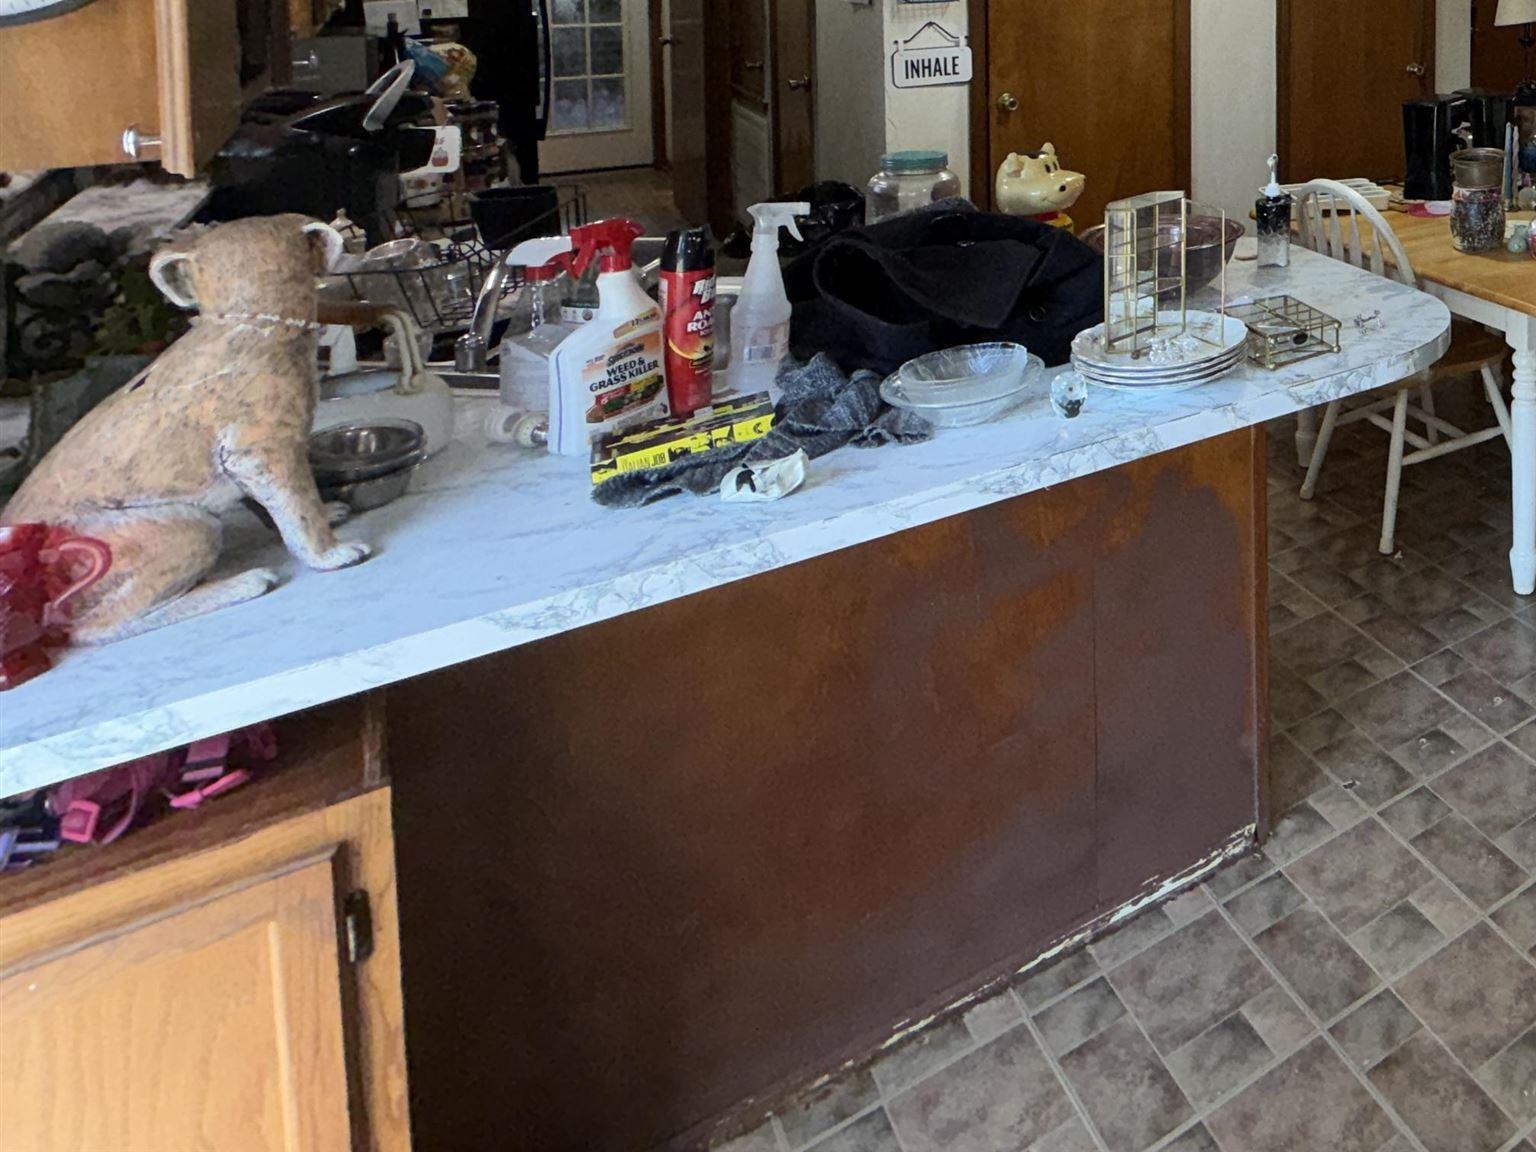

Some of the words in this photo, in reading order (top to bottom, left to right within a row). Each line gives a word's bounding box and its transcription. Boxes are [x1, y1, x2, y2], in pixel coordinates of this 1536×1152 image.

[904, 56, 960, 80] INHALE
[589, 372, 627, 392] GRASS
[628, 359, 659, 379] KILLER
[606, 360, 637, 377] WEED
[637, 357, 646, 367] &
[650, 452, 667, 469] JOB
